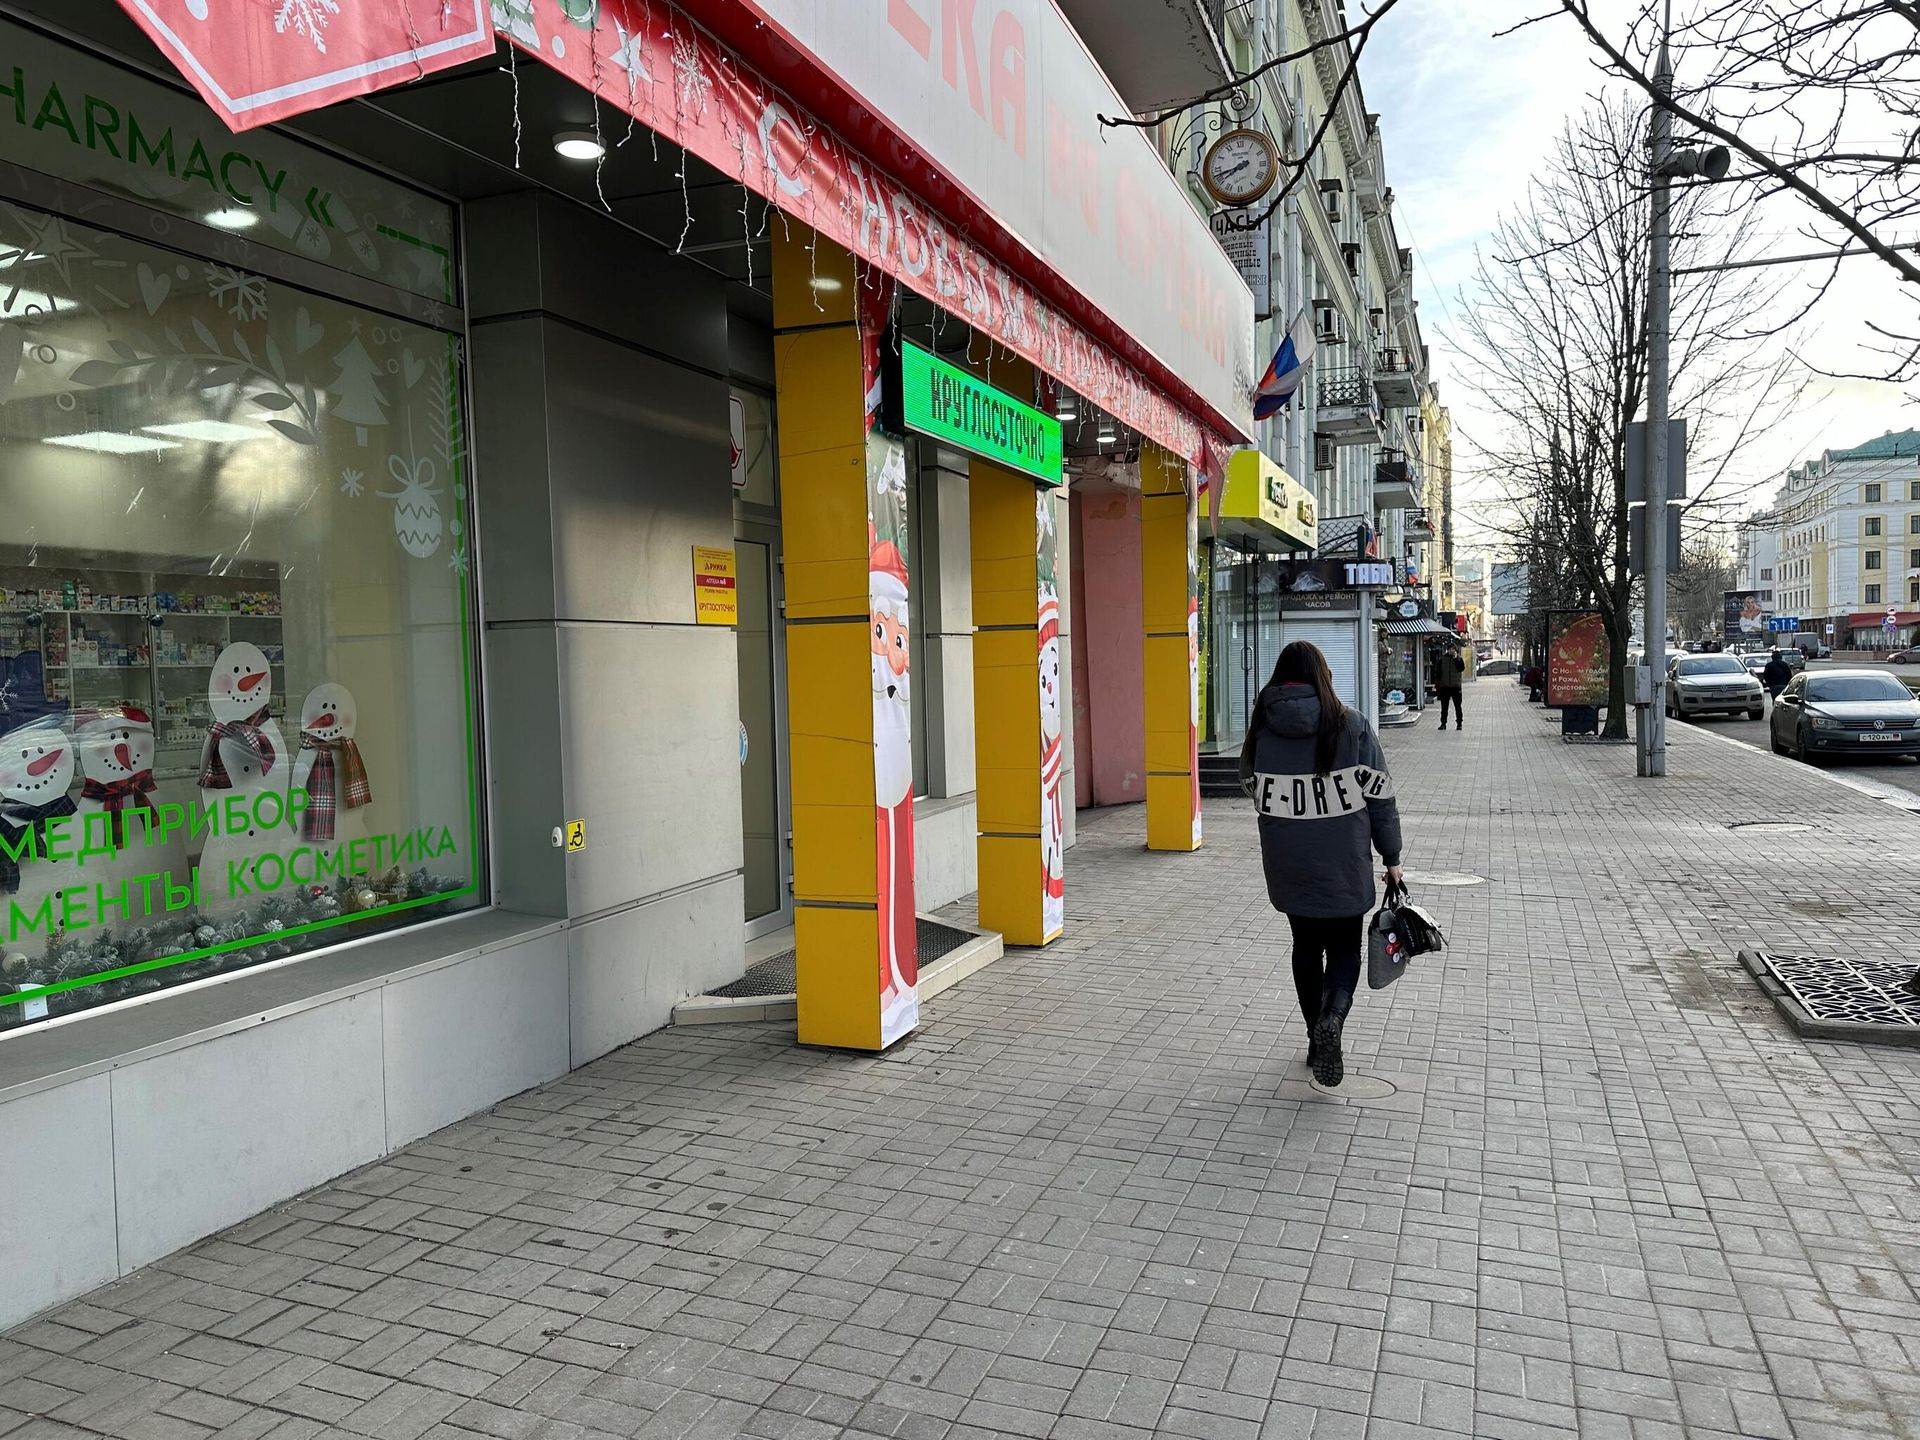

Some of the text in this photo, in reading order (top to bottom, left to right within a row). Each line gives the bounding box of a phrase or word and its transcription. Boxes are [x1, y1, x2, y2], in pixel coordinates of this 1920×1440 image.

[1216, 214, 1262, 236] ЧАСЫ
[930, 366, 1045, 464] КРУГЛОСУТОЧНО
[1325, 592, 1355, 600] РЕМОНТ
[0, 788, 310, 865] МЕДПРИБОР
[0, 824, 457, 945] МЕНТЫ, КОСМЕТИКА
